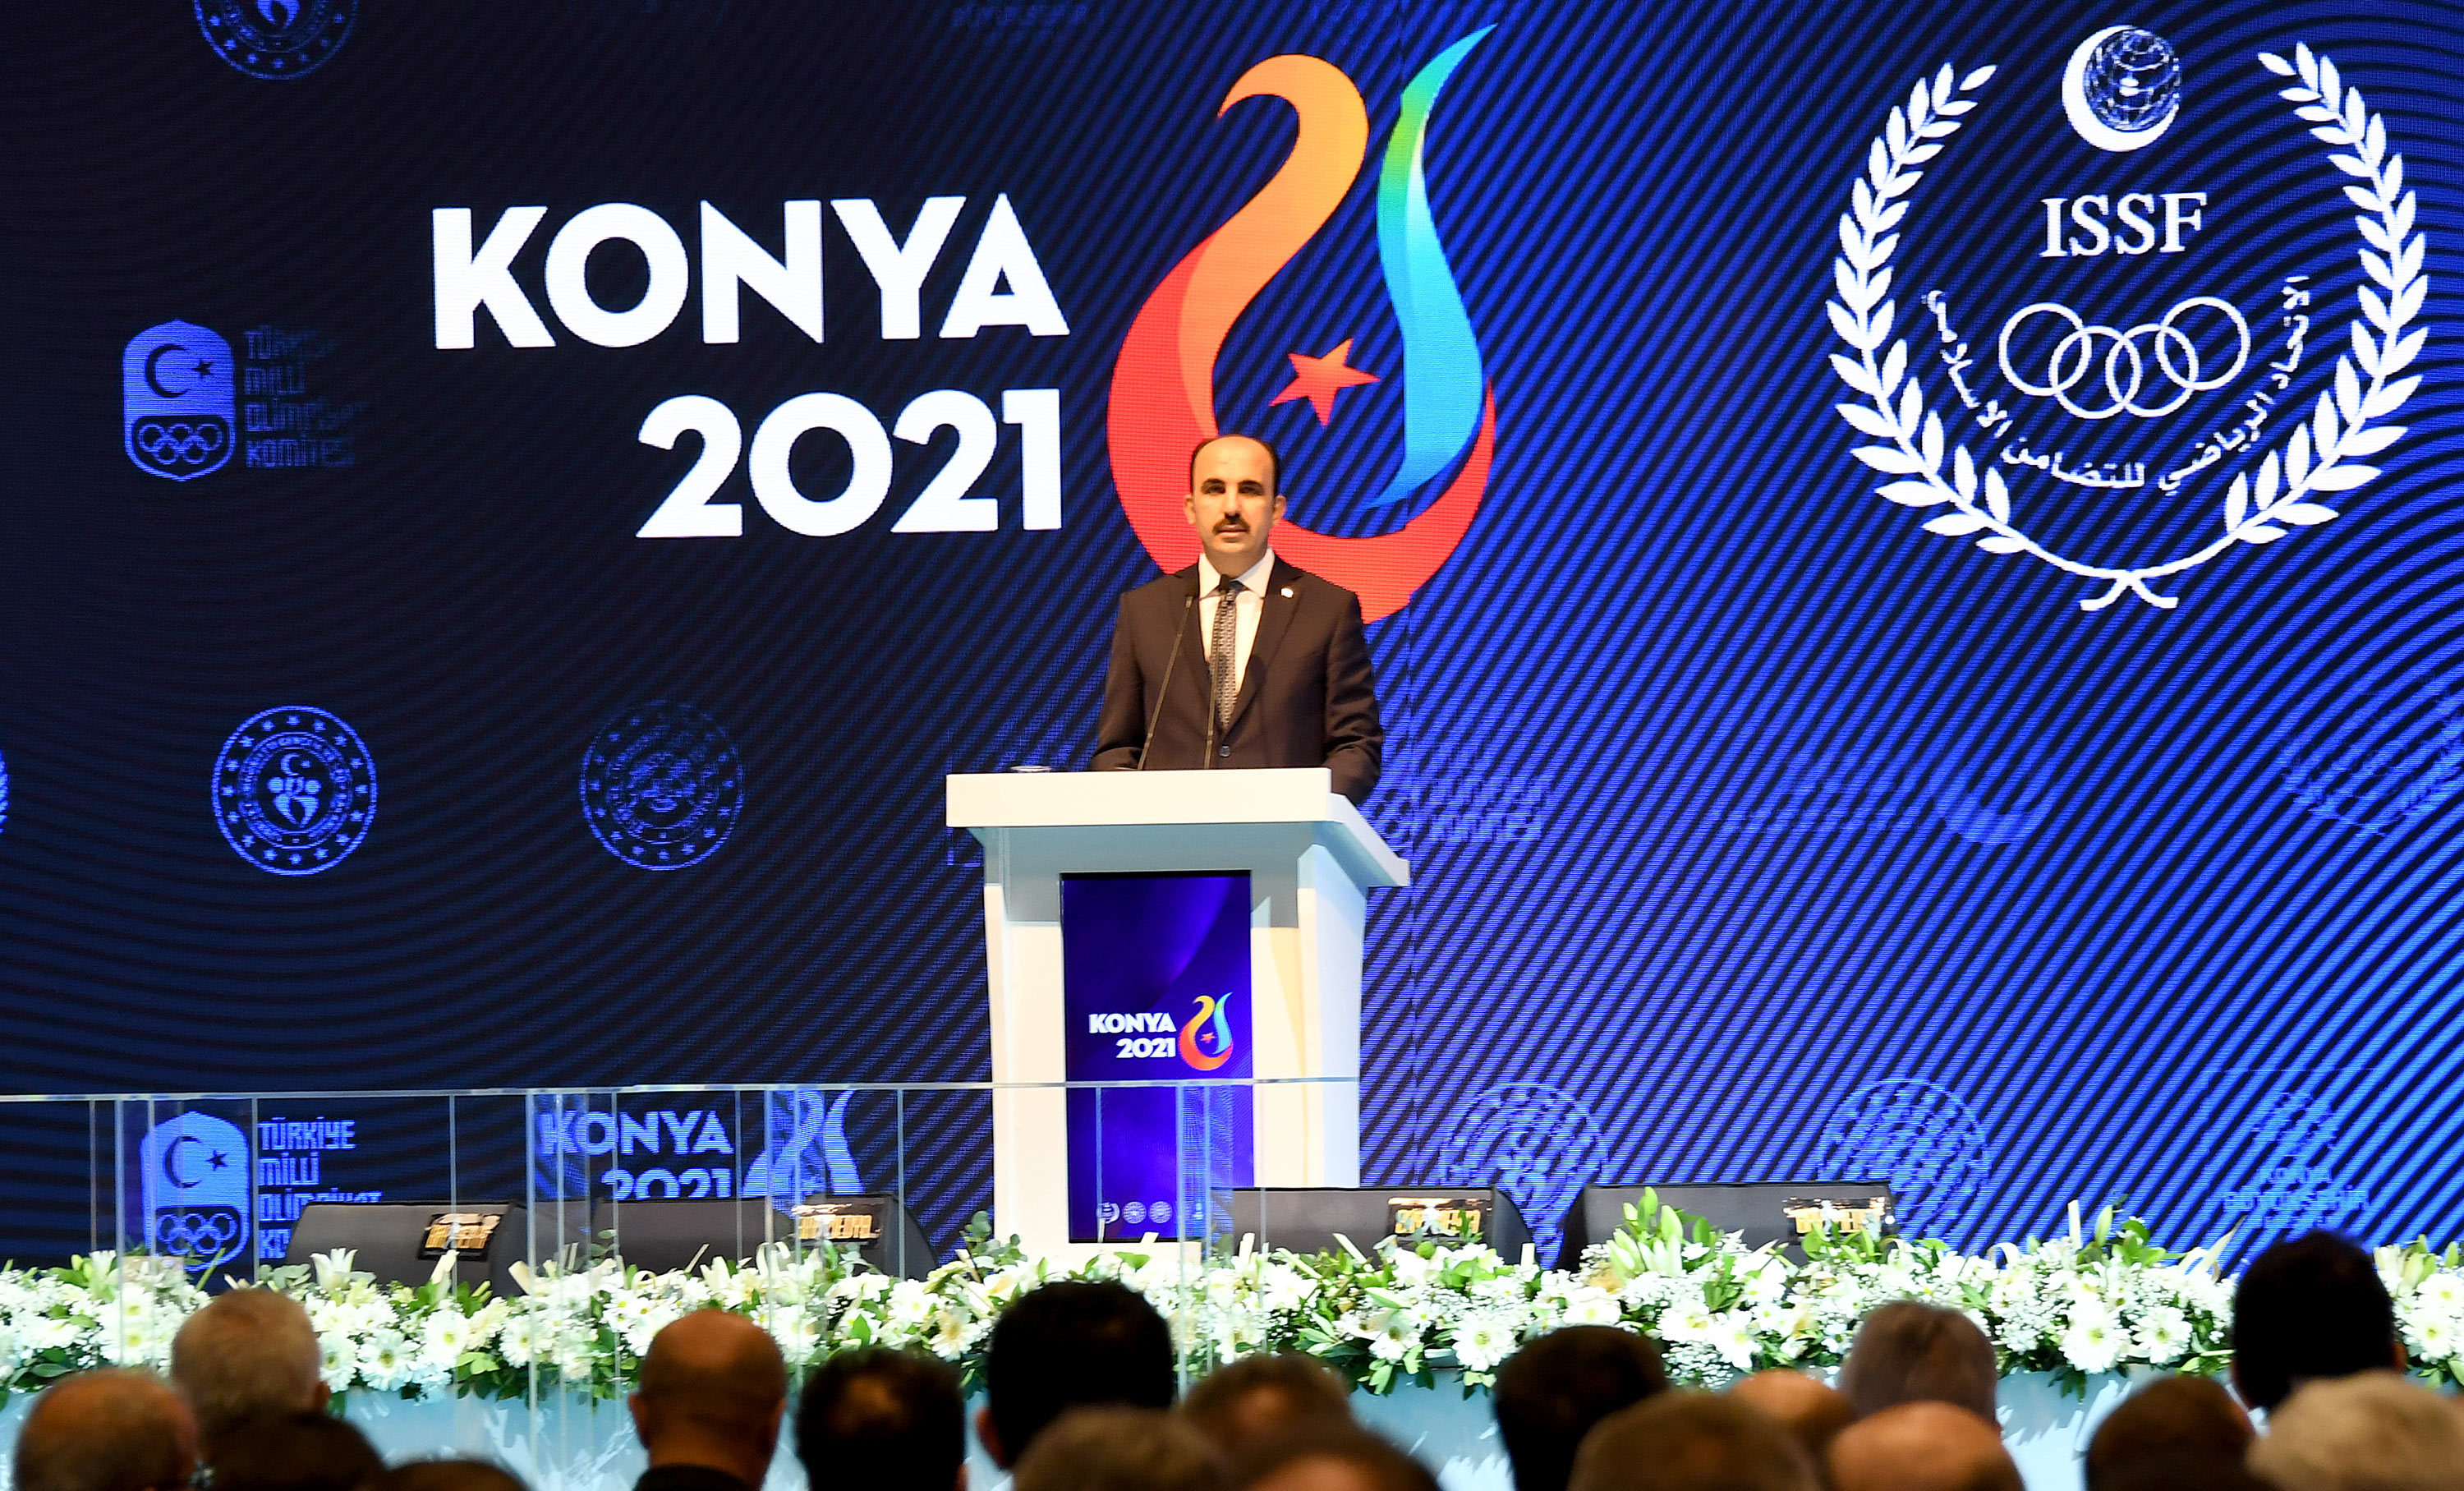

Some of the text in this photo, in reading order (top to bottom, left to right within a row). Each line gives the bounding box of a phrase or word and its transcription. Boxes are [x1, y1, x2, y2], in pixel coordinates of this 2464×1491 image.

[2039, 192, 2208, 258] ISSF
[432, 195, 1069, 349] KONYA
[636, 389, 1063, 538] 2021
[1087, 1011, 1177, 1034] KONYA
[1115, 1037, 1177, 1059] 2021
[257, 1116, 356, 1150] TÜRKİYE
[539, 1110, 734, 1156] KONYA
[601, 1167, 733, 1200] 2021
